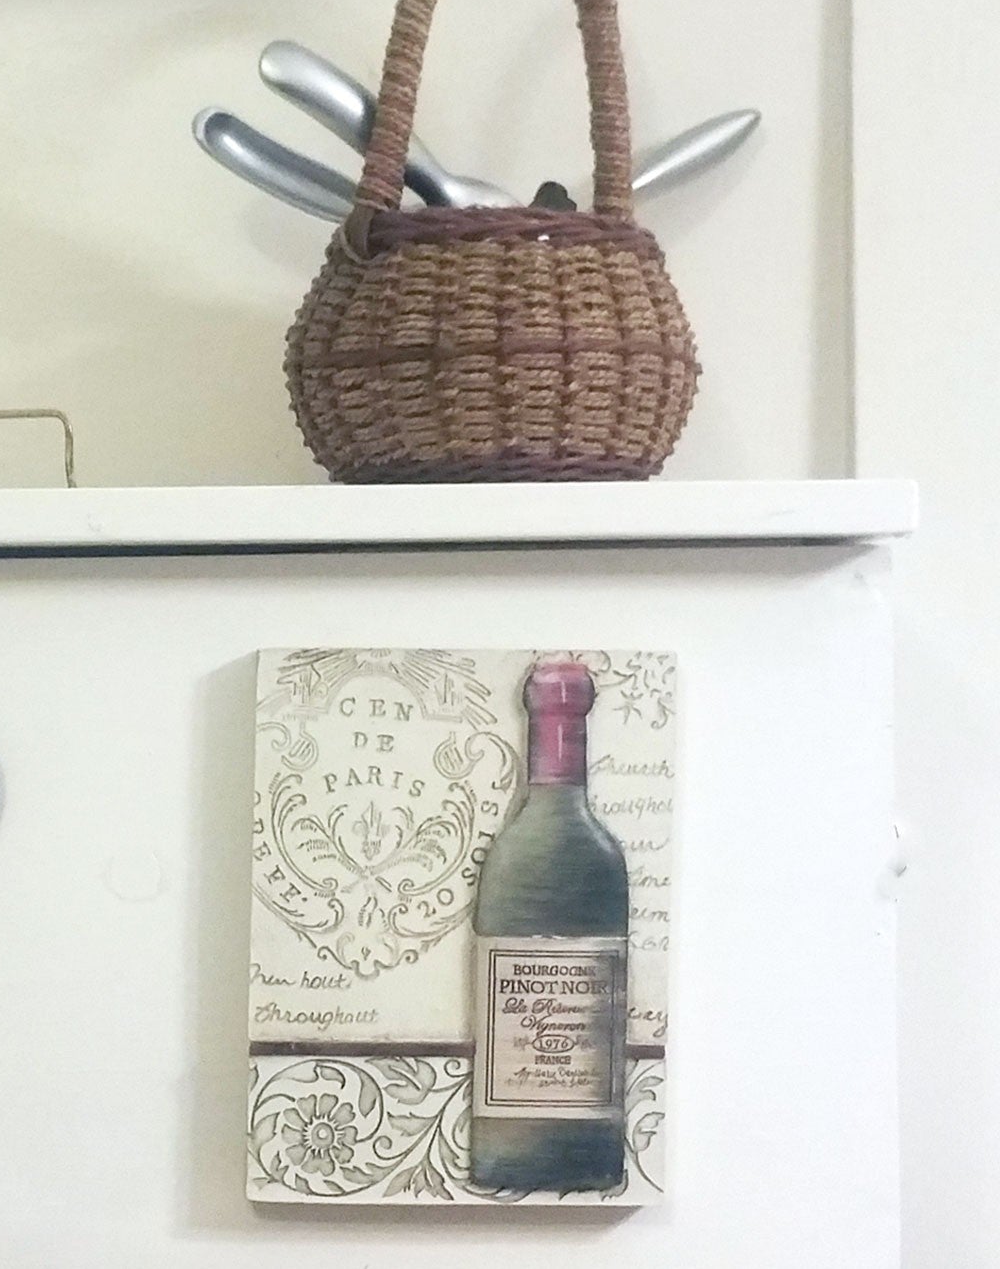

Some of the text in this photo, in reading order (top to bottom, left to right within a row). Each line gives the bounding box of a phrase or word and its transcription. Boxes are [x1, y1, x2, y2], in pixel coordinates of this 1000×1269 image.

[353, 732, 394, 753] DE
[323, 766, 426, 798] PARIS
[499, 979, 608, 995] PINOT NOIR
[537, 1038, 570, 1051] 1976
[534, 1055, 572, 1066] FRANCE
